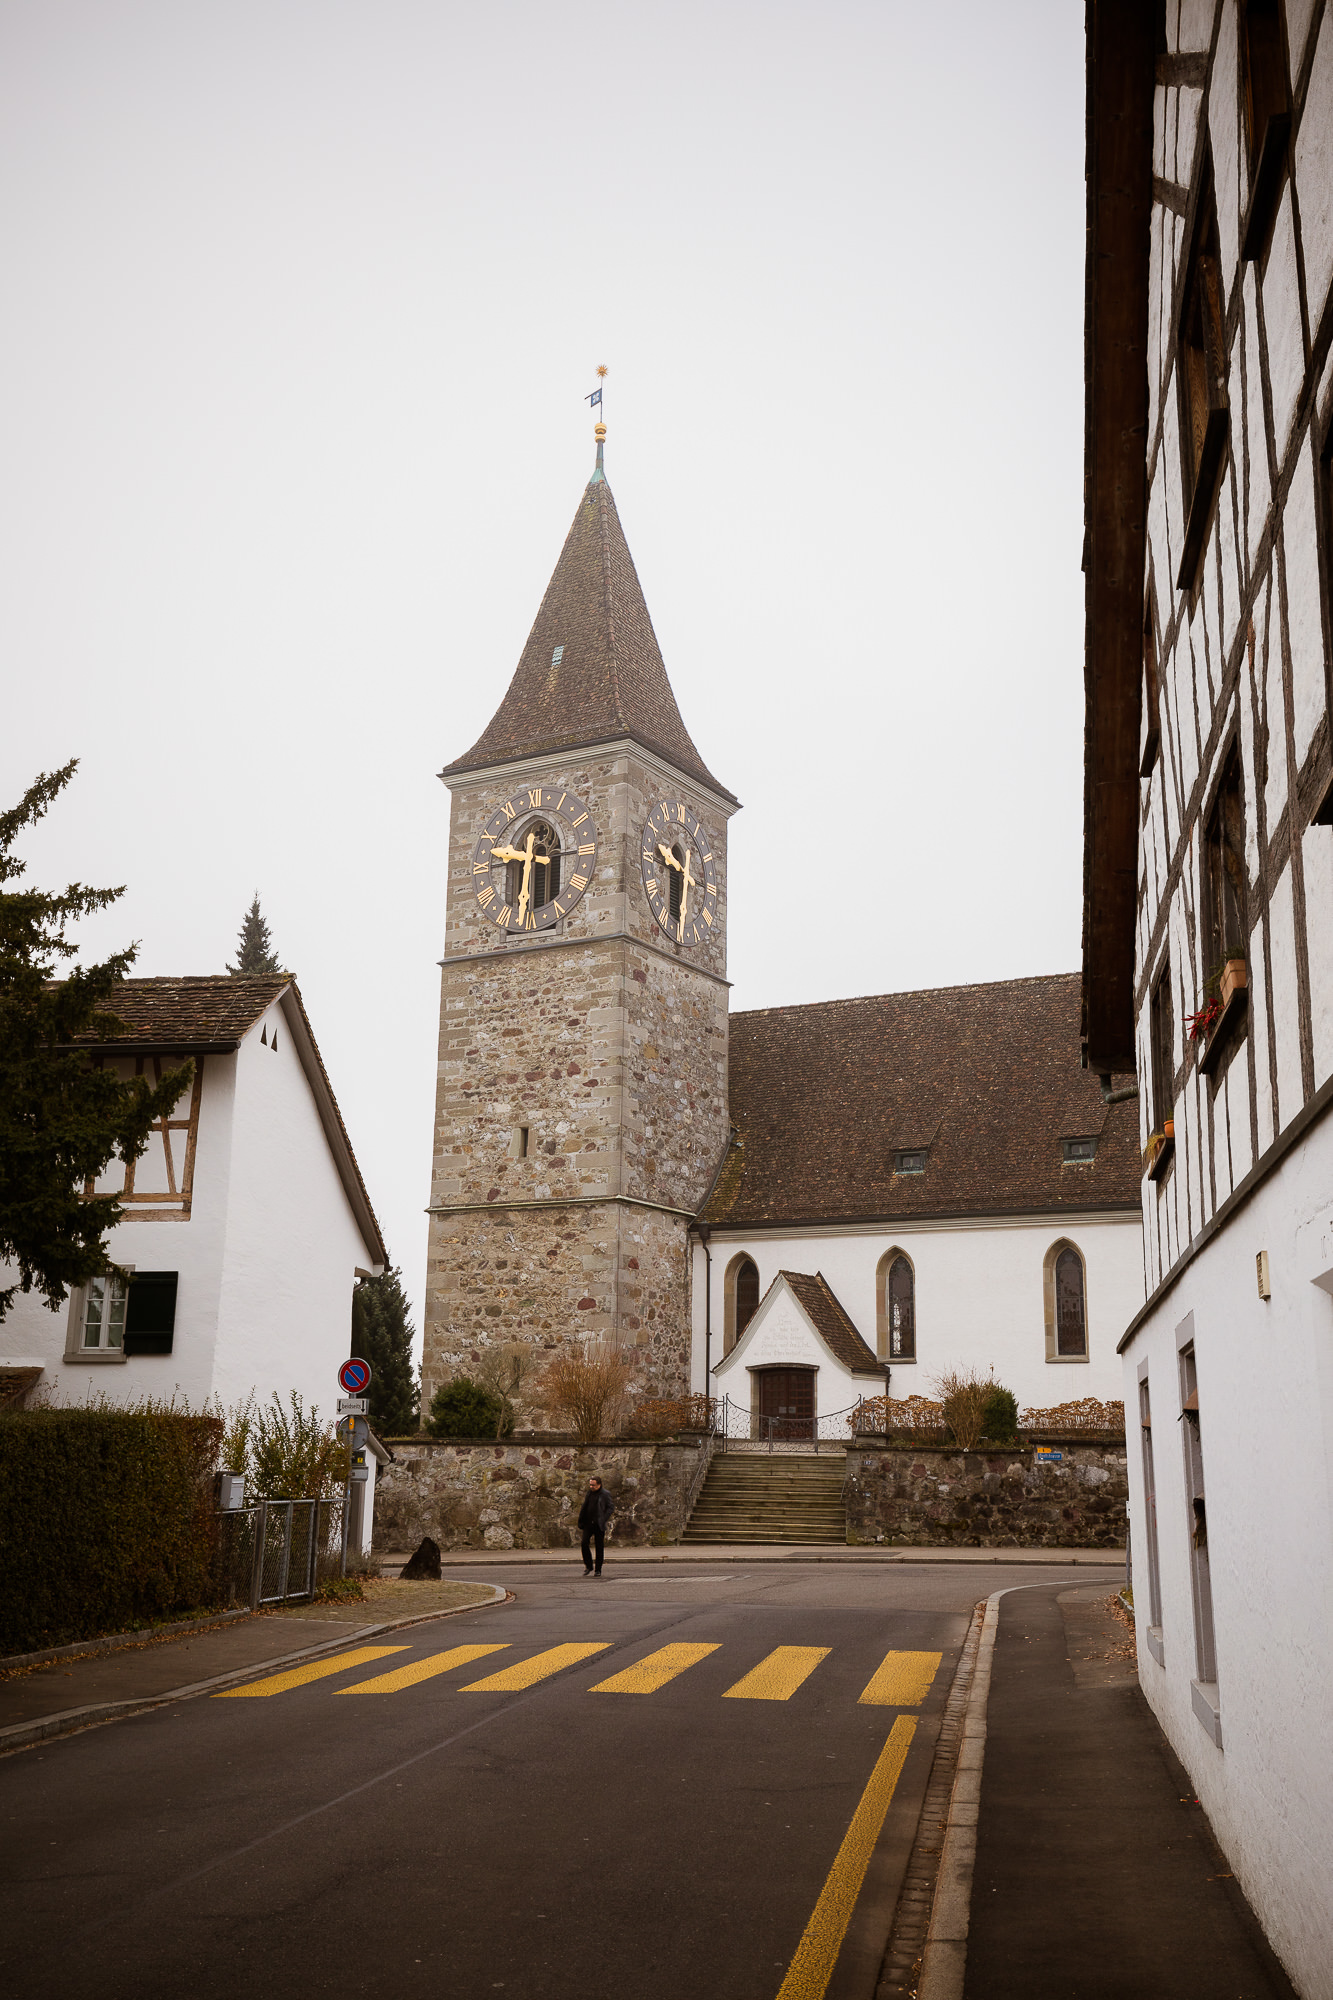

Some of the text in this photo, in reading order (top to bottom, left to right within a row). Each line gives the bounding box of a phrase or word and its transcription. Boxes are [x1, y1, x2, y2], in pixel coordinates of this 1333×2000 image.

[528, 788, 542, 809] XII
[556, 792, 567, 810] I
[501, 801, 516, 822] XI
[572, 811, 589, 828] II
[481, 829, 497, 844] X
[578, 842, 595, 856] III
[473, 861, 489, 875] IX
[569, 873, 588, 891] IIII
[477, 886, 495, 909] VIII
[496, 905, 512, 928] VII
[553, 900, 565, 918] V
[525, 911, 537, 930] VI
